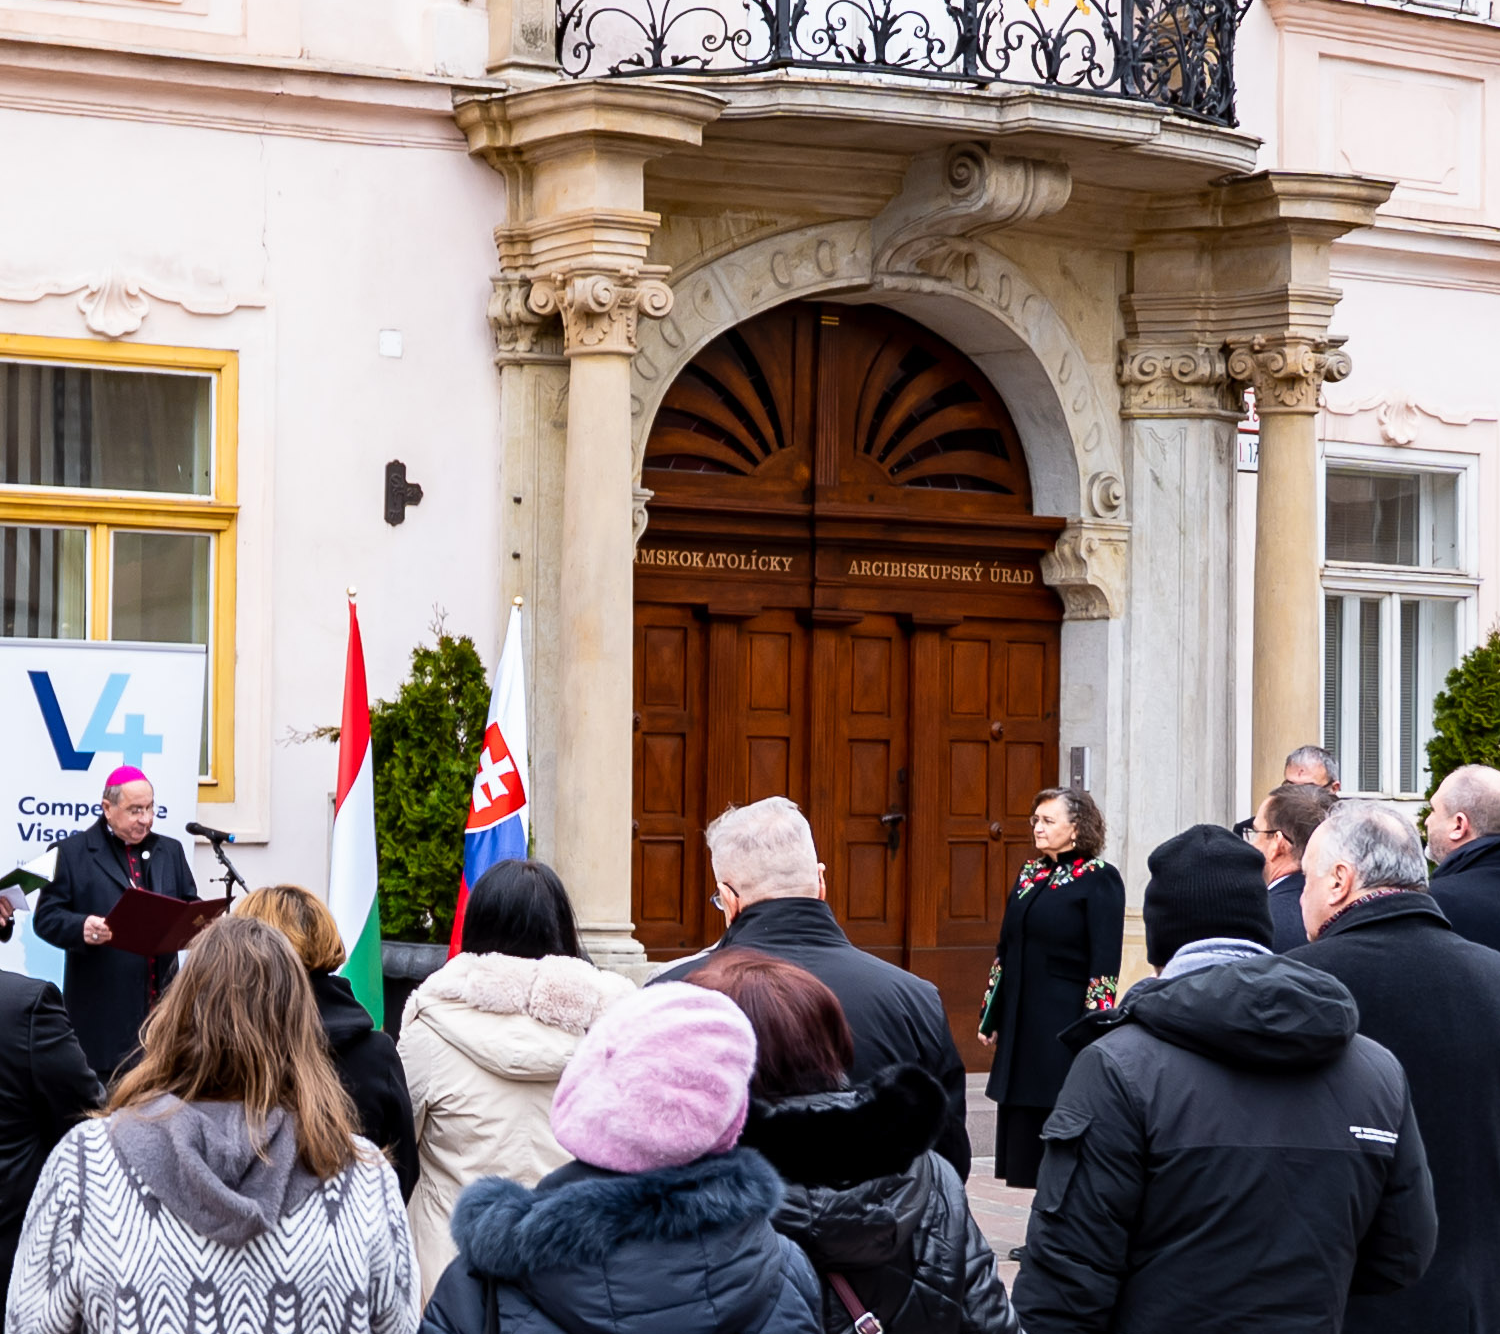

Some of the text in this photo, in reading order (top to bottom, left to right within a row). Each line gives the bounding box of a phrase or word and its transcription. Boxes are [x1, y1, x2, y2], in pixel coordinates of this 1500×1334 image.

[634, 548, 793, 572] IMSKOKATOLÍCKY
[848, 560, 1034, 584] ARCIBISKUPSKÝ ÚRAD
[27, 669, 164, 771] V4
